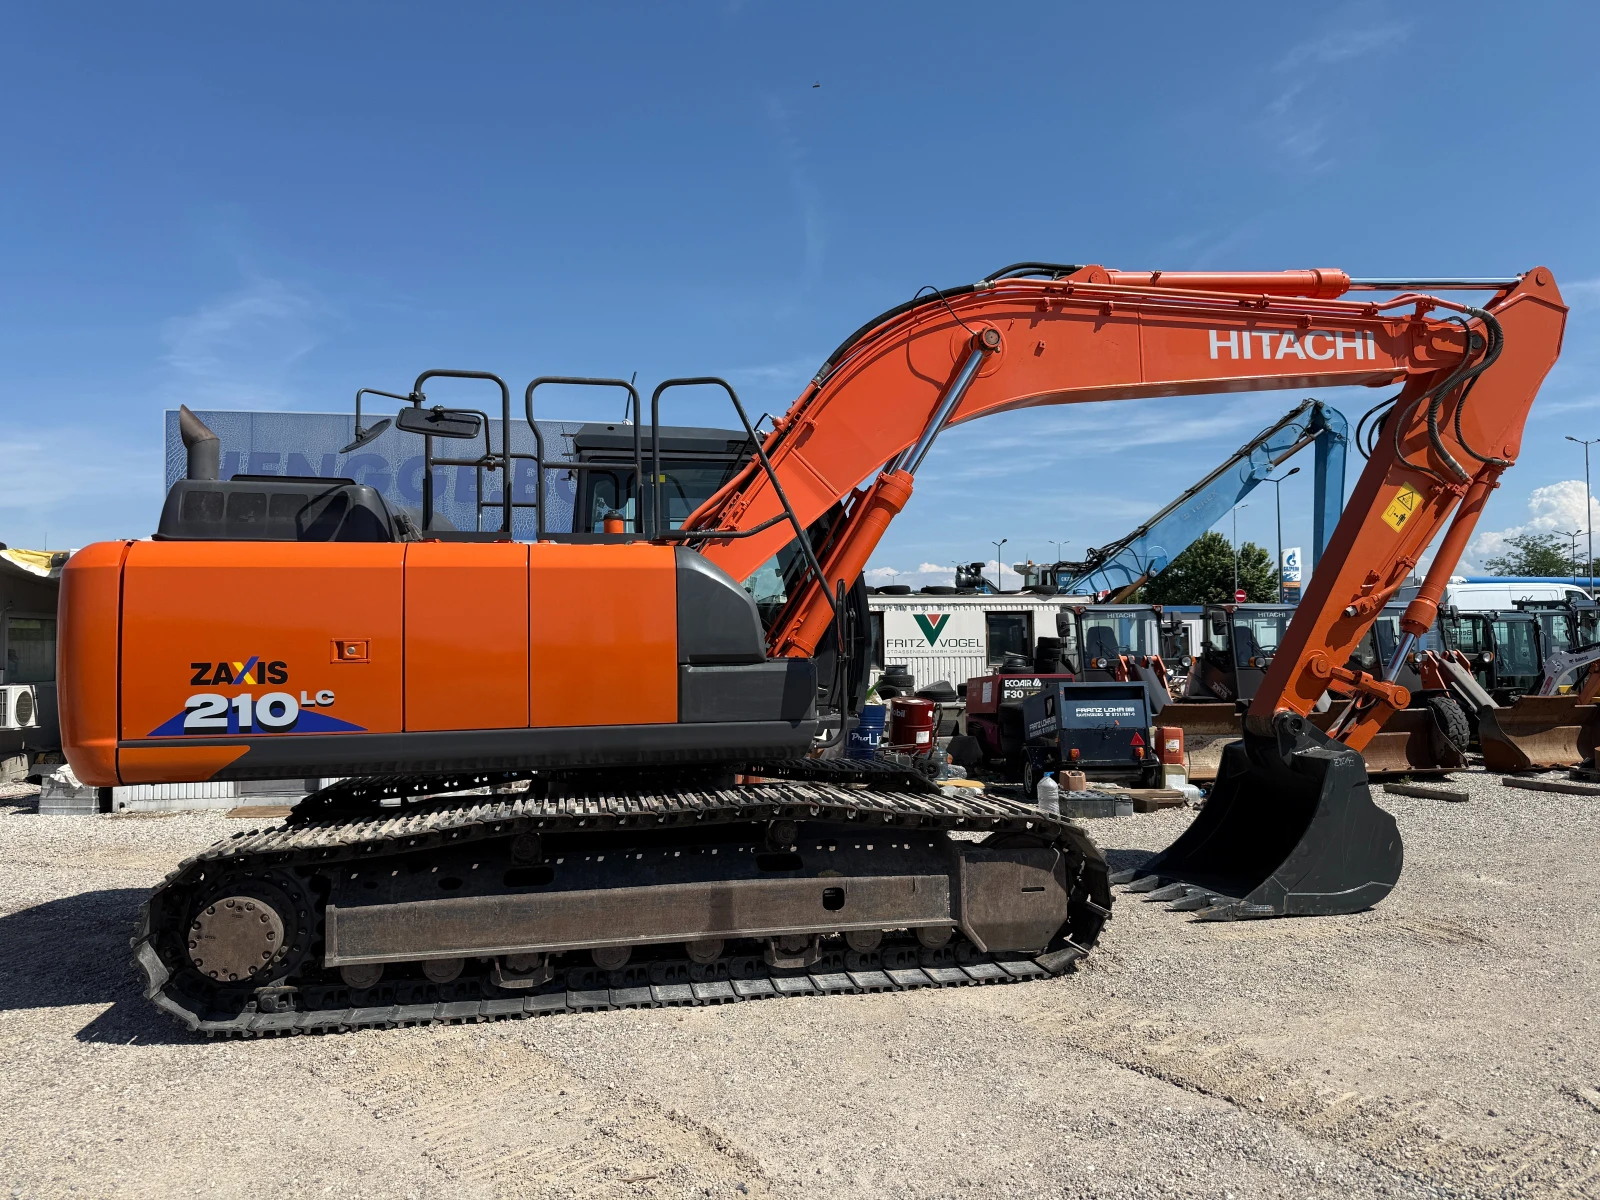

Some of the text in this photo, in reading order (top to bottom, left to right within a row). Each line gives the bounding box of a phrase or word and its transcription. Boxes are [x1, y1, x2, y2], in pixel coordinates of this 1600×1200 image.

[1208, 329, 1377, 361] HITACHI
[886, 638, 984, 648] FRITZ VOGEL
[190, 655, 288, 685] ZAXIS
[1004, 679, 1032, 688] ECOAIR
[1003, 690, 1024, 699] F30
[183, 689, 335, 733] 210 LC
